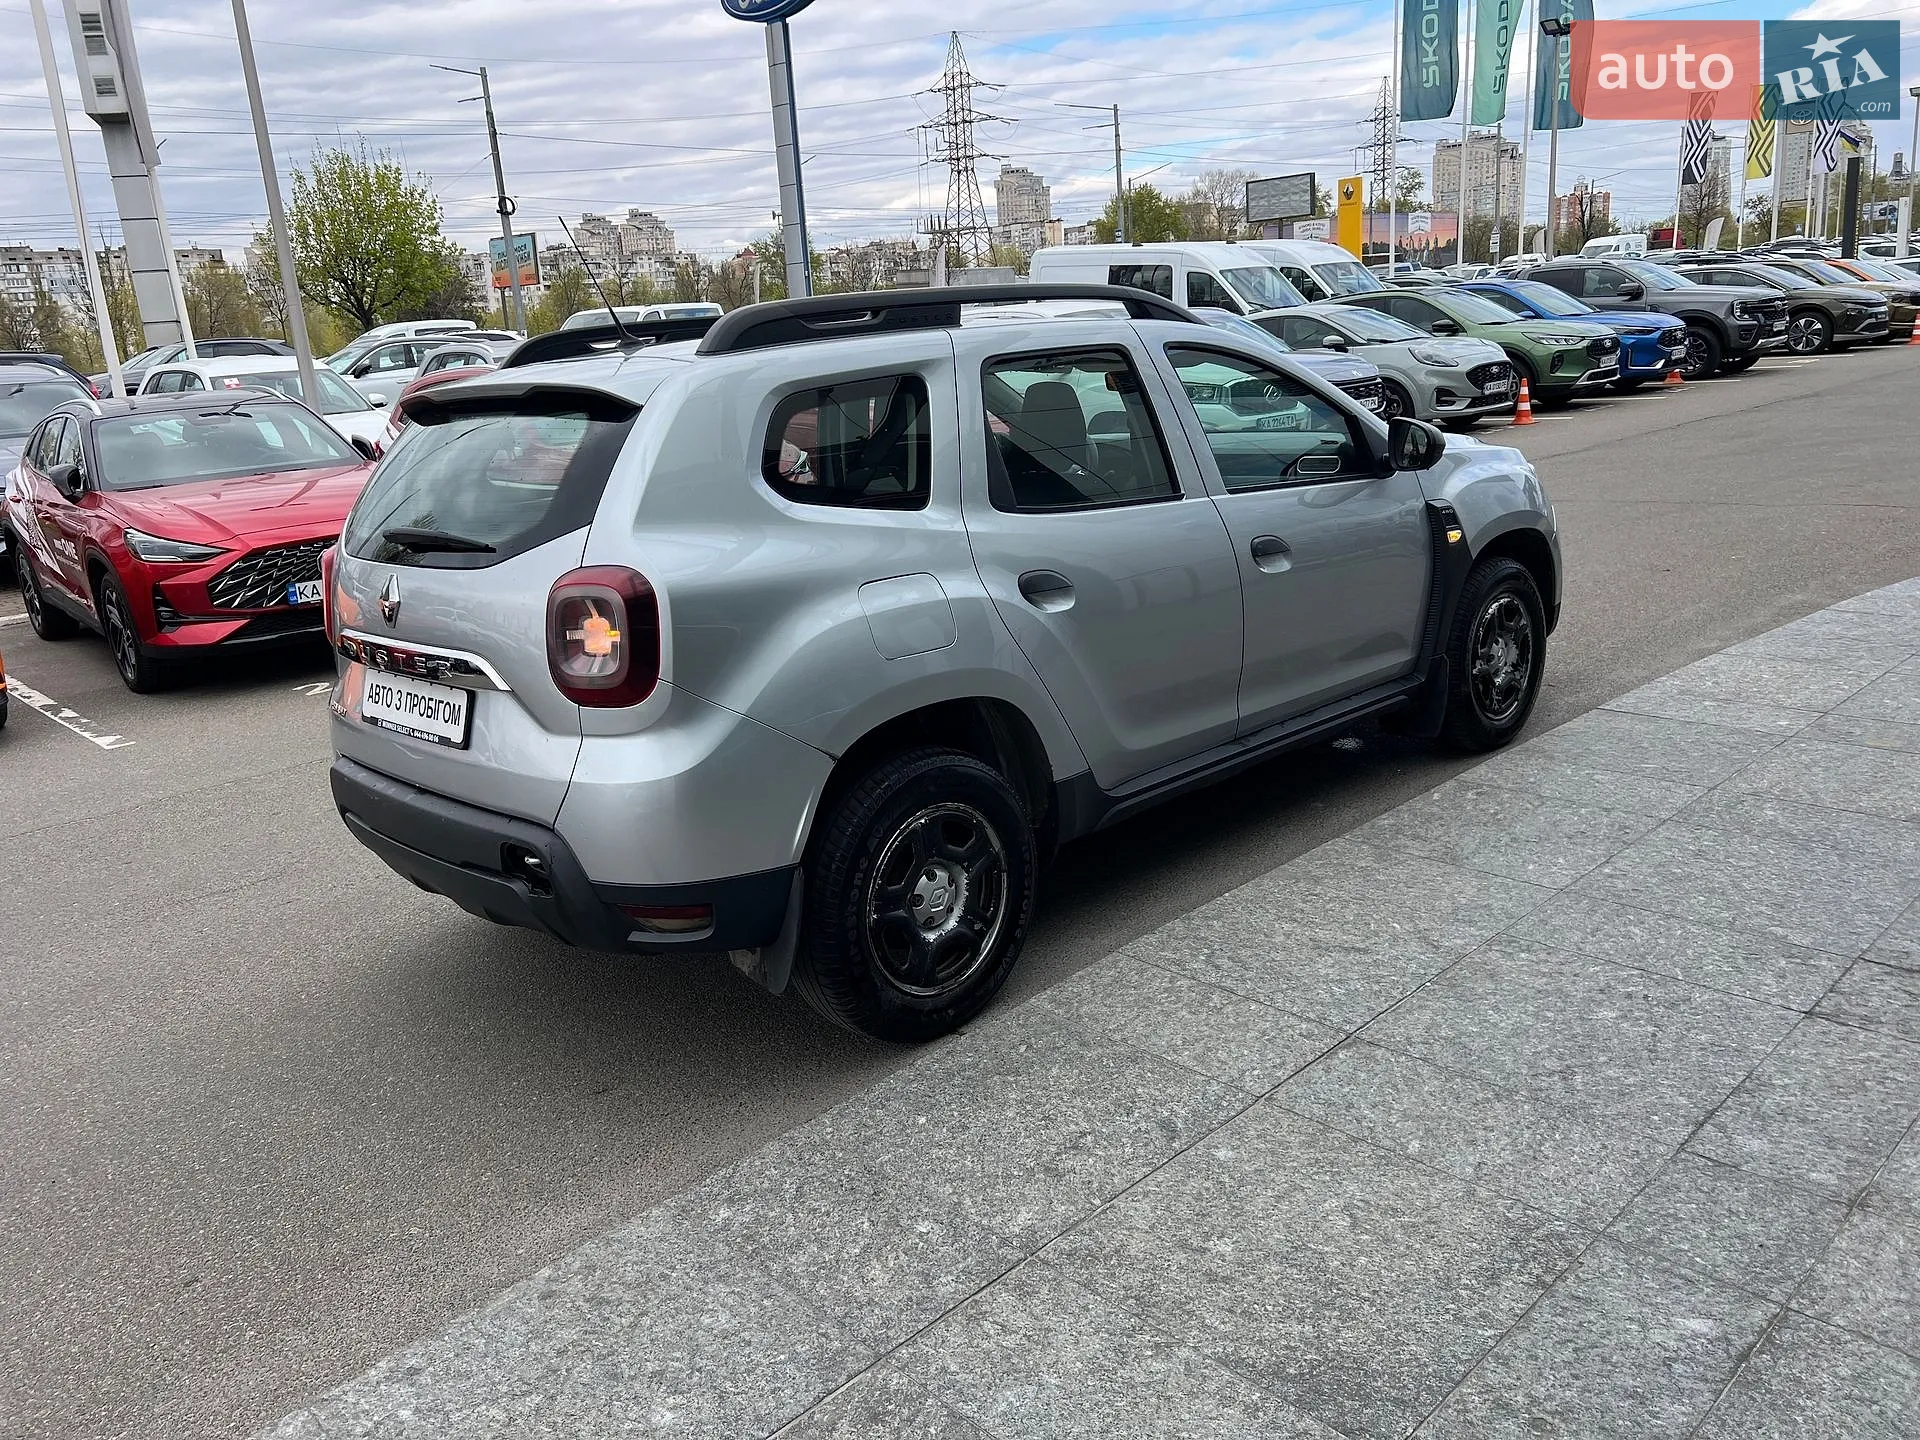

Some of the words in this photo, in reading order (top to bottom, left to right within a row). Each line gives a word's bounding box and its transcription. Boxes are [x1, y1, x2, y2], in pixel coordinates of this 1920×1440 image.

[298, 584, 322, 600] KA
[343, 640, 453, 678] DUSTER
[367, 683, 394, 709] АВТО
[404, 691, 462, 727] ПРОБІГОМ
